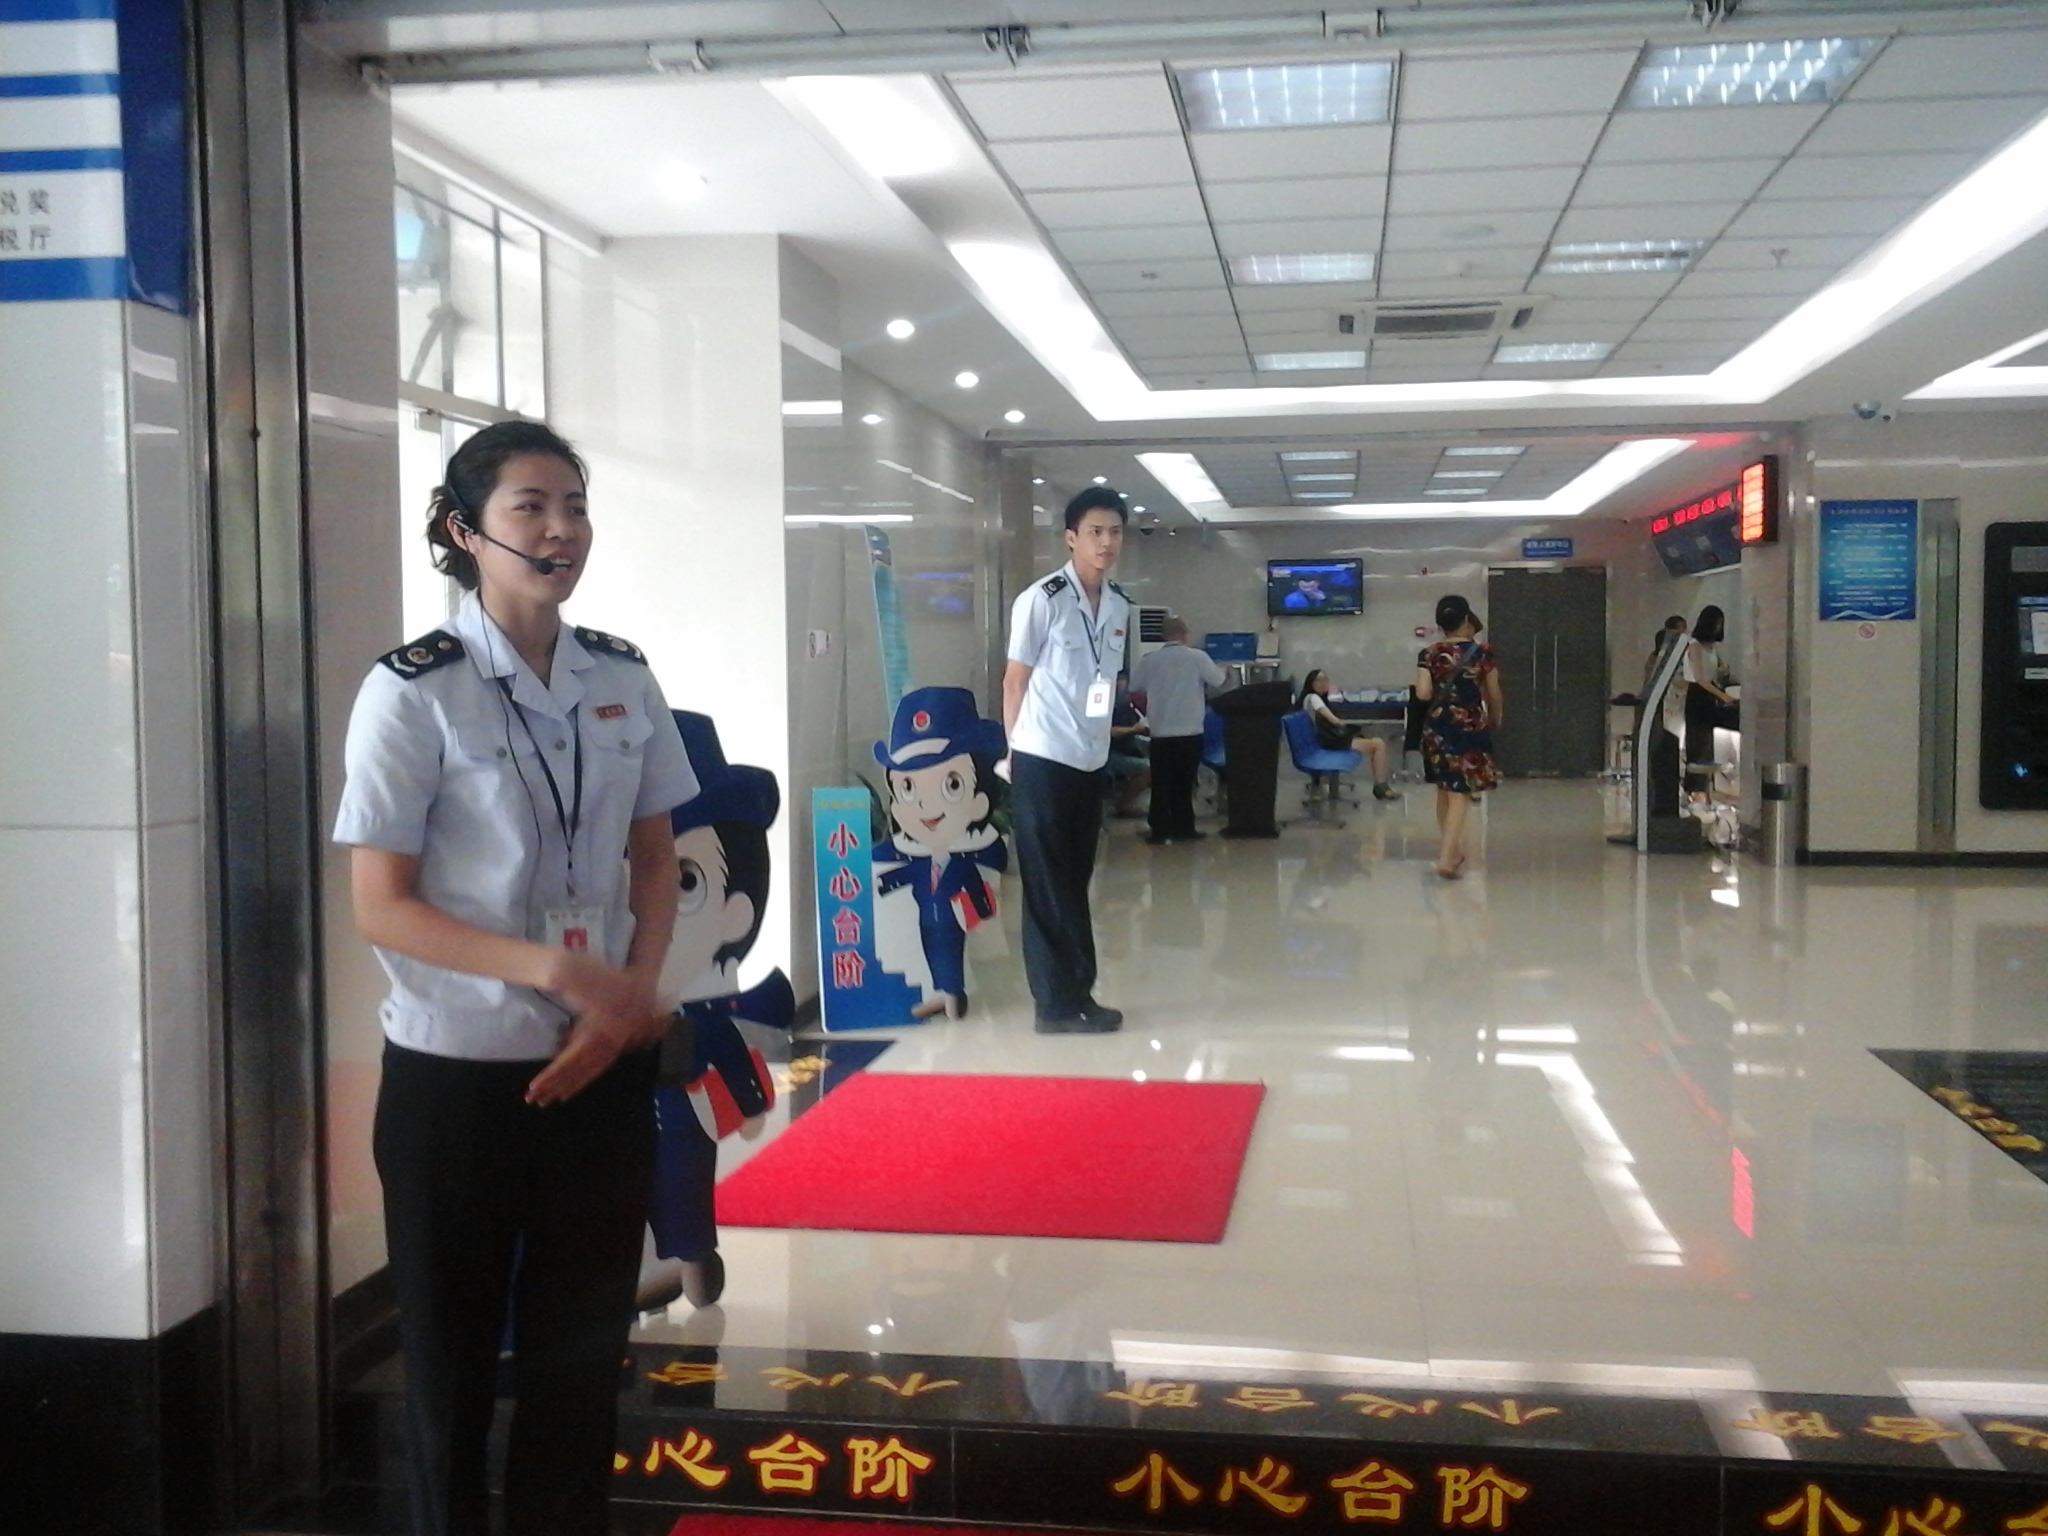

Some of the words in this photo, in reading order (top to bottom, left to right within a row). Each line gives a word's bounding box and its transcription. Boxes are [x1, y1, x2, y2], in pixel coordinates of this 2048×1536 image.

[827, 822, 867, 987] 小心台阶
[622, 1357, 960, 1397] 小心台
[612, 1429, 932, 1499] 心台阶
[1113, 1452, 1528, 1528] 小心台阶
